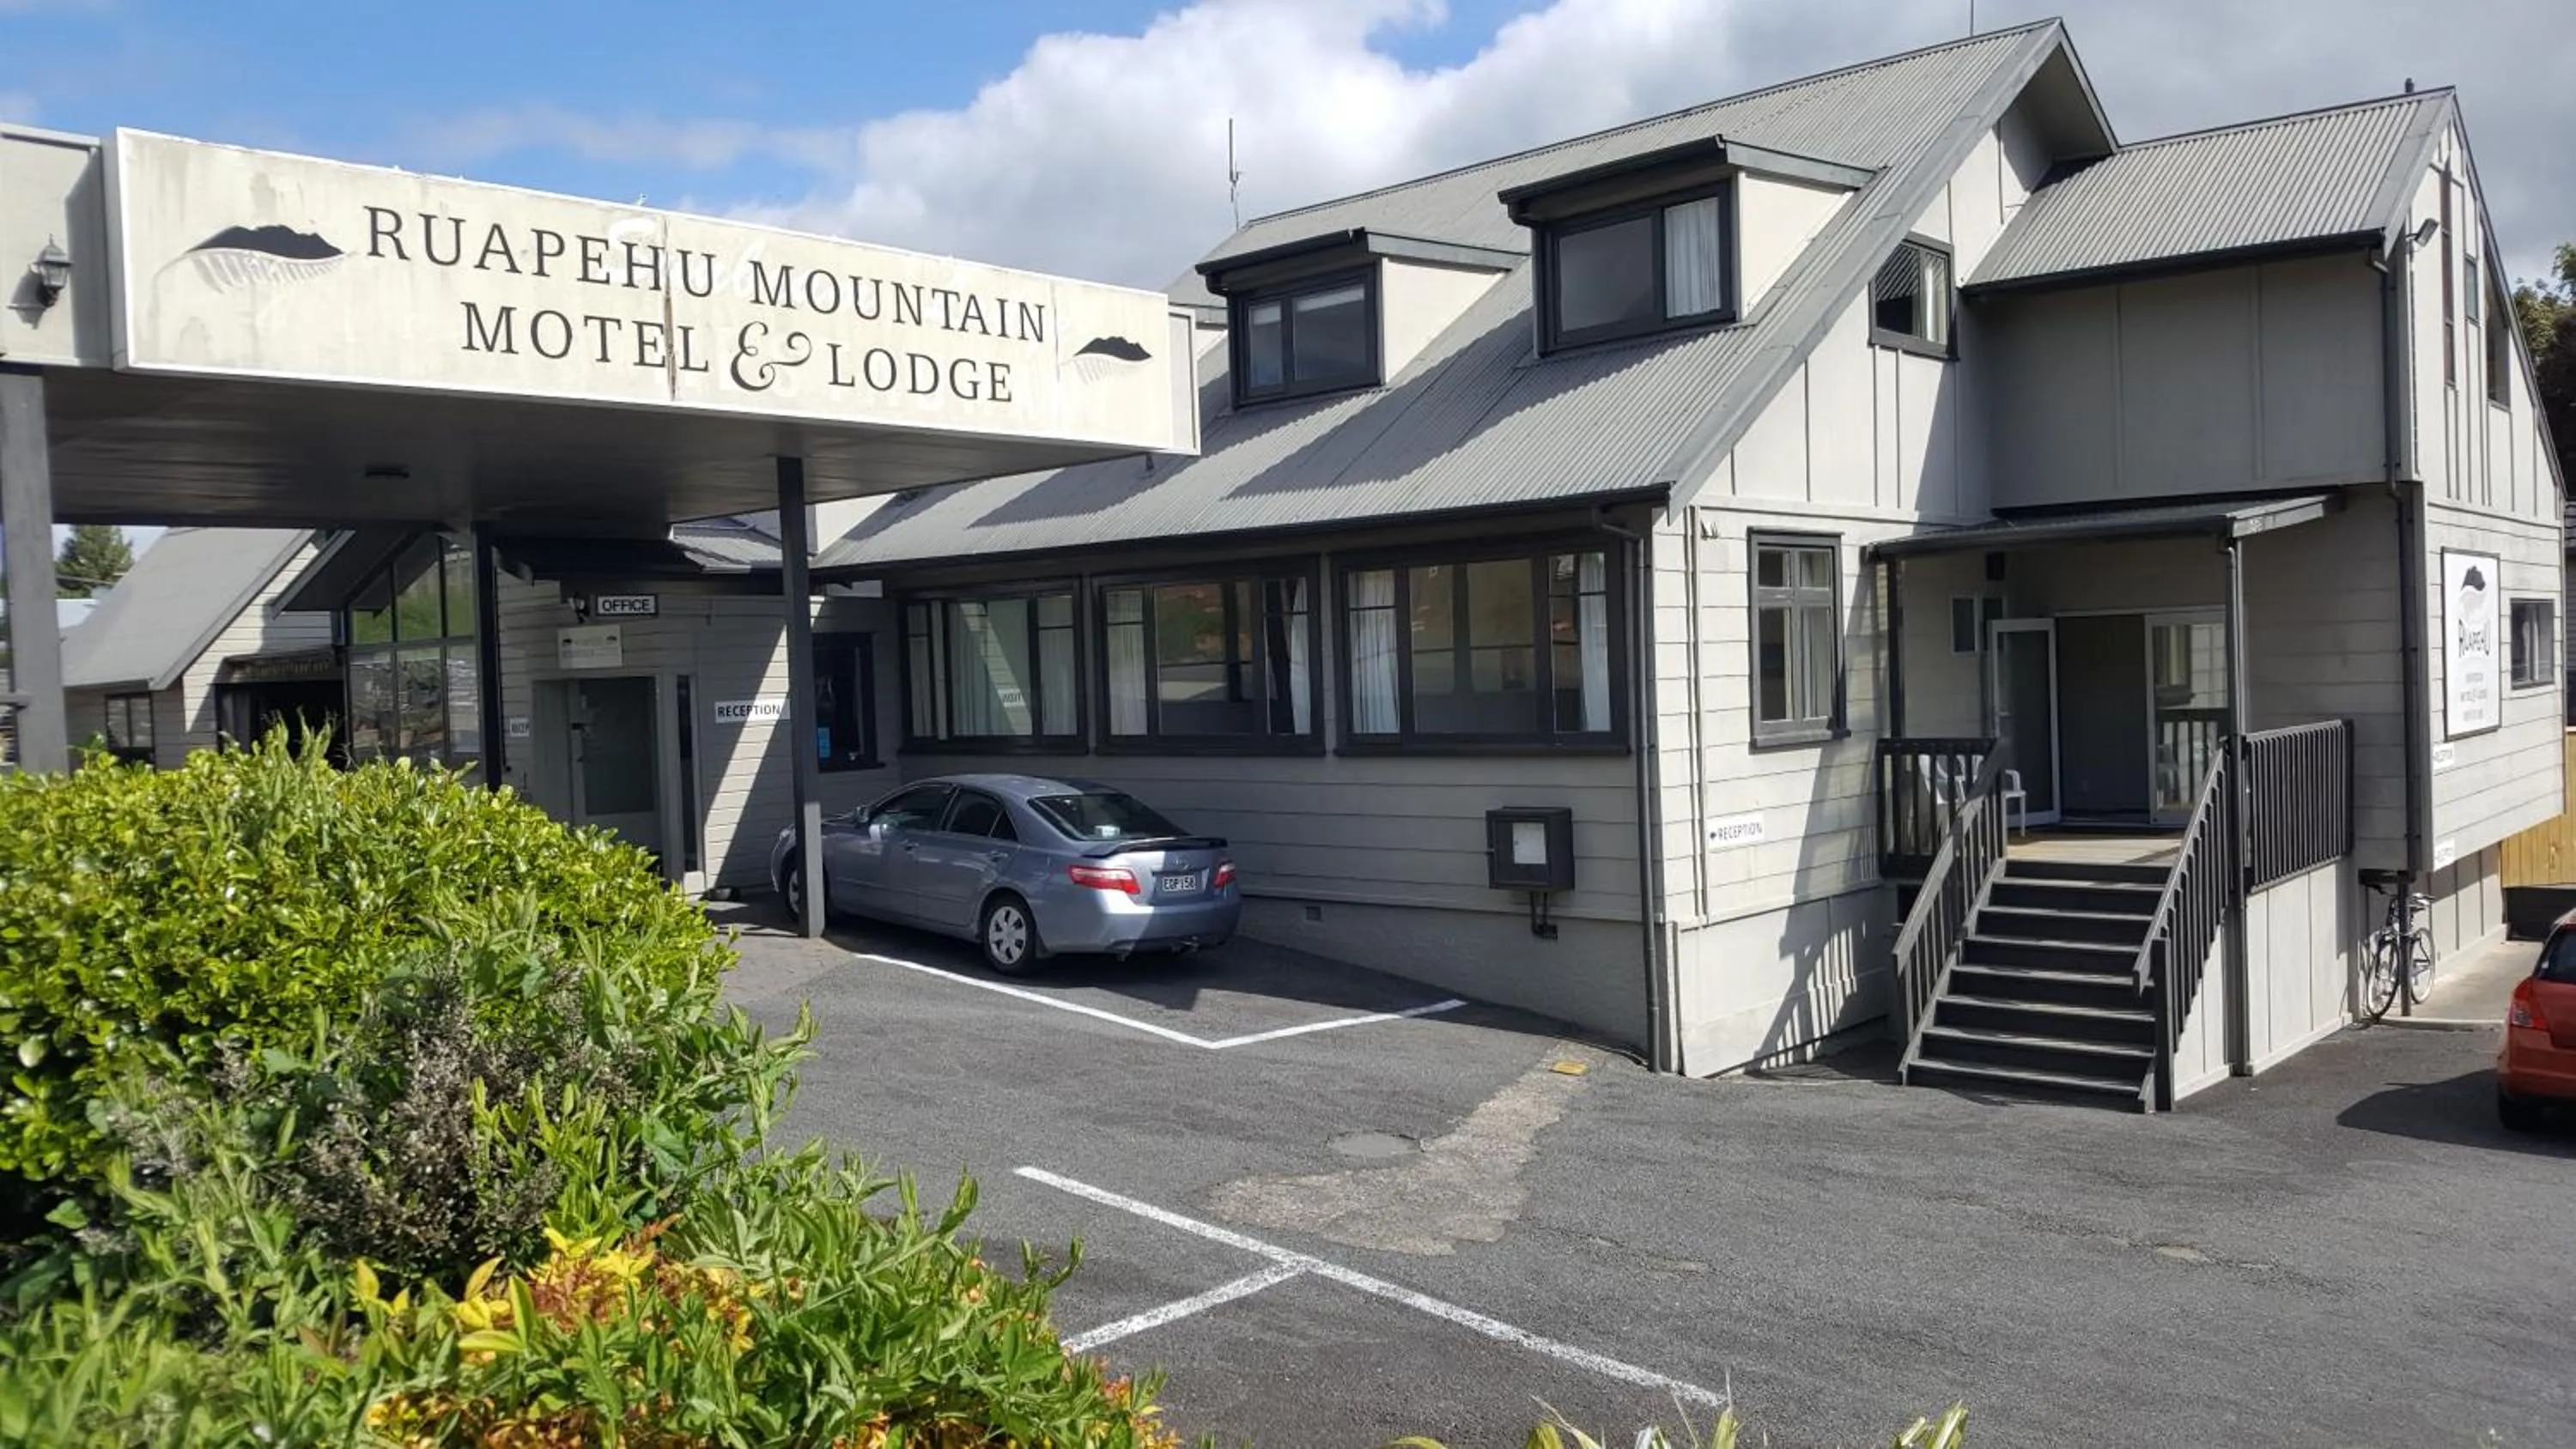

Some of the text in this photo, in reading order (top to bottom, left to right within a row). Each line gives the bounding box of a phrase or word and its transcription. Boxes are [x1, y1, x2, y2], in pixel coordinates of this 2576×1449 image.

[363, 205, 1045, 343] RUAPEHU MOUNTAIN
[460, 300, 1012, 403] MOTEL & LODGE
[601, 598, 651, 613] OFFICE
[717, 704, 781, 718] RECEPTION
[1717, 822, 1763, 840] RECEPTION
